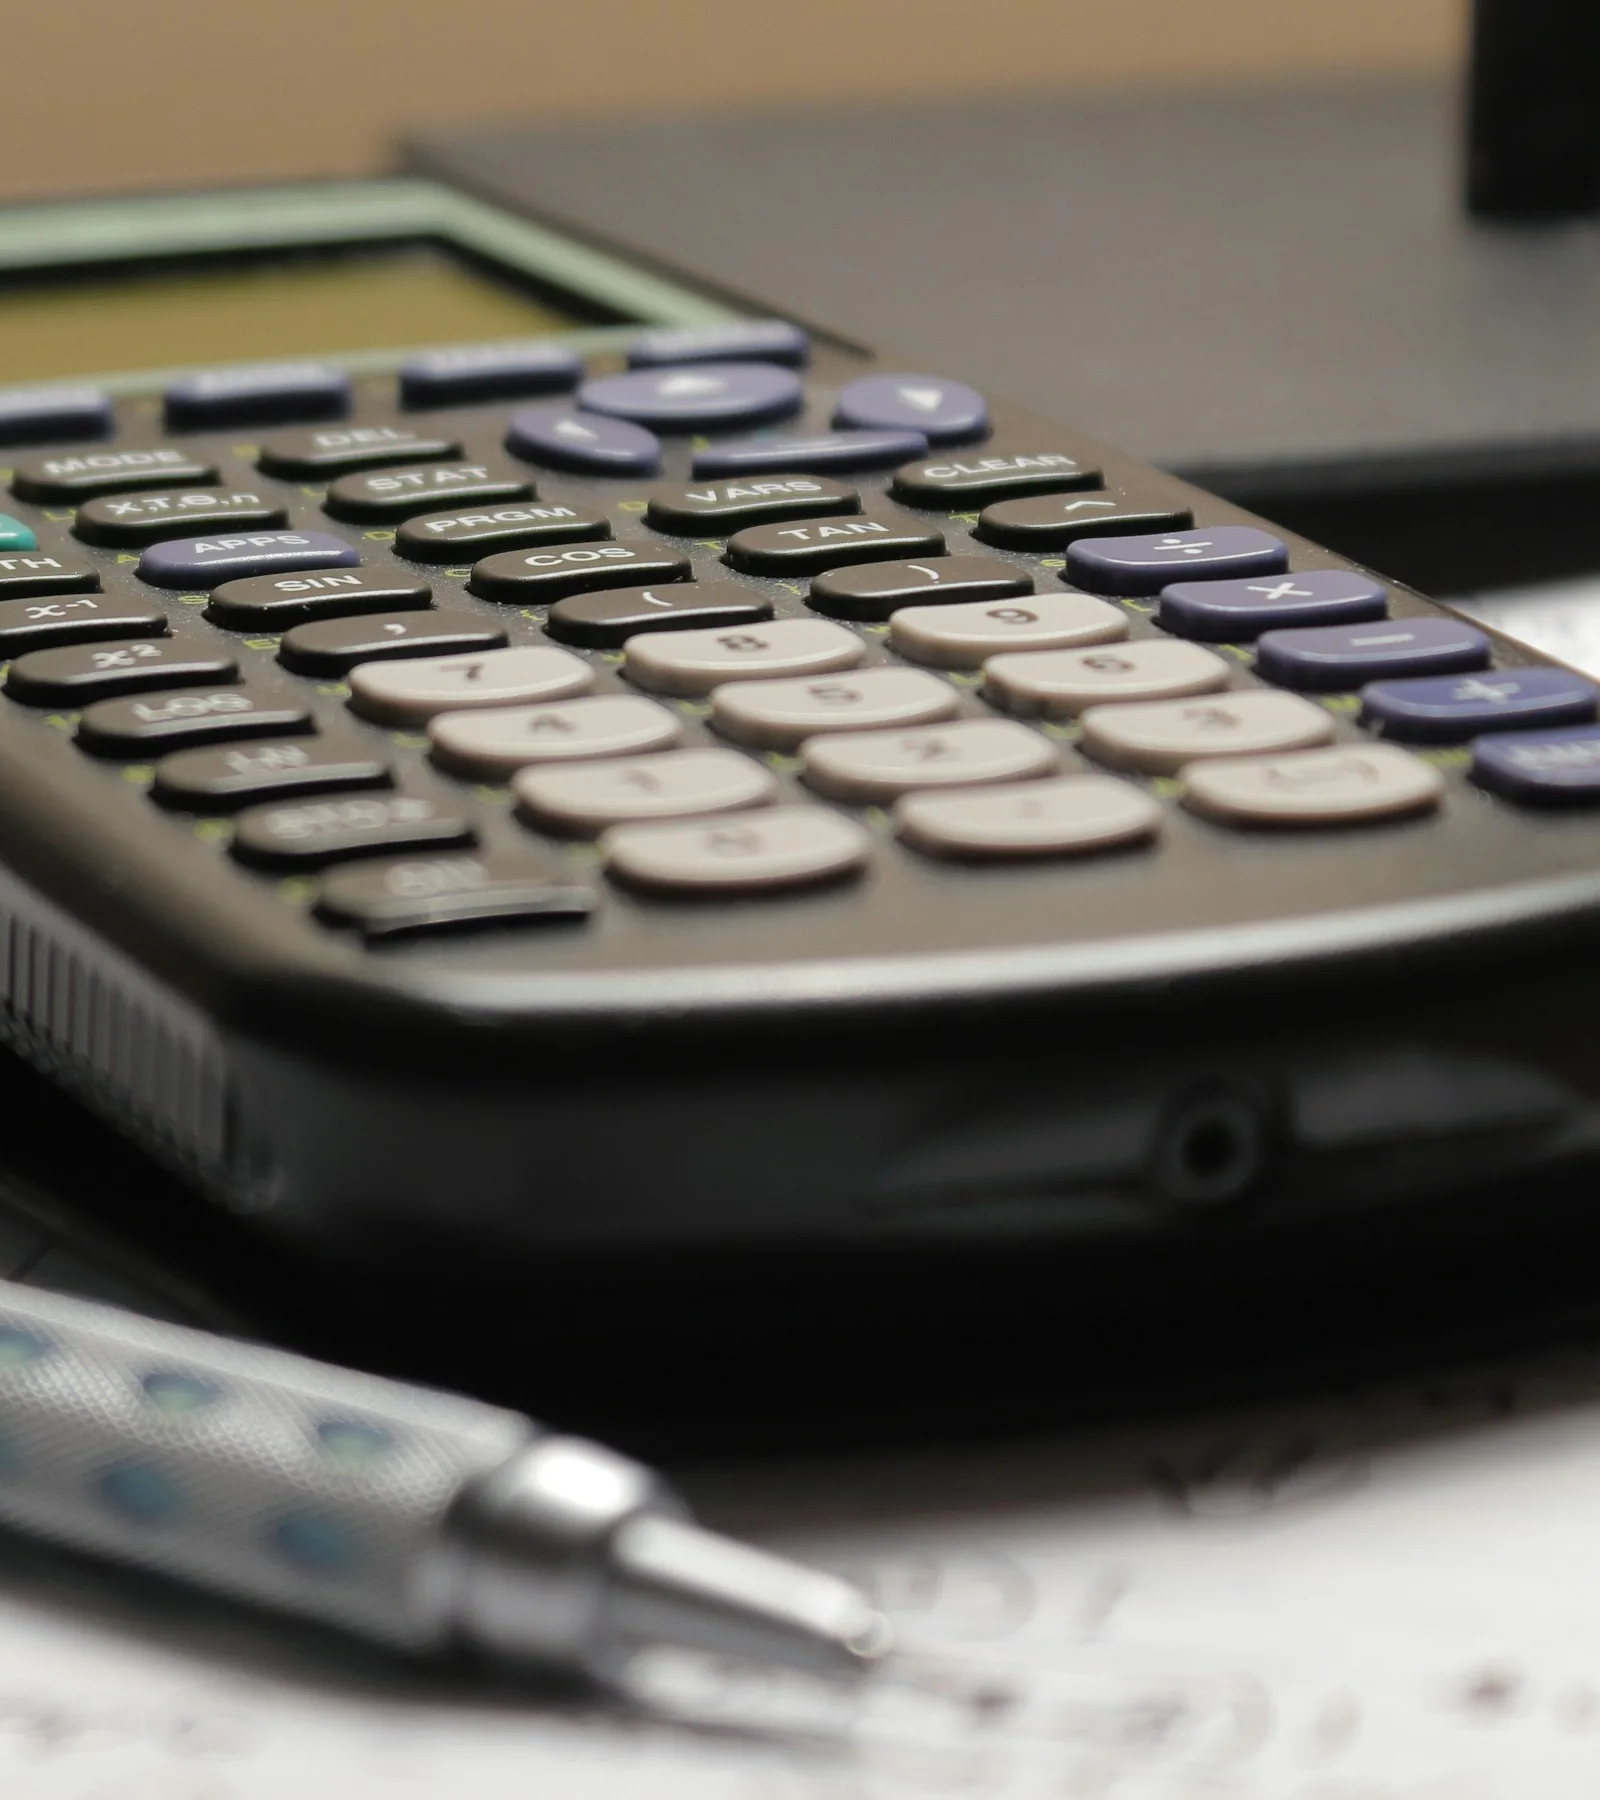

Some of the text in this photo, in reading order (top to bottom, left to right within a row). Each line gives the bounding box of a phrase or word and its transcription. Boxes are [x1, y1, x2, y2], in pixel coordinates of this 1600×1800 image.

[313, 427, 418, 448] DEL
[43, 449, 188, 475] MODE
[923, 454, 1077, 479] CLEAR
[366, 466, 489, 491] STAT
[685, 480, 823, 503] VARS
[424, 506, 578, 533] PRGM
[777, 520, 890, 541] TAN
[193, 534, 311, 555] APPS
[524, 547, 636, 567] COS
[273, 574, 364, 592] SIN
[985, 607, 1039, 625] 9
[131, 692, 254, 722] LOG
